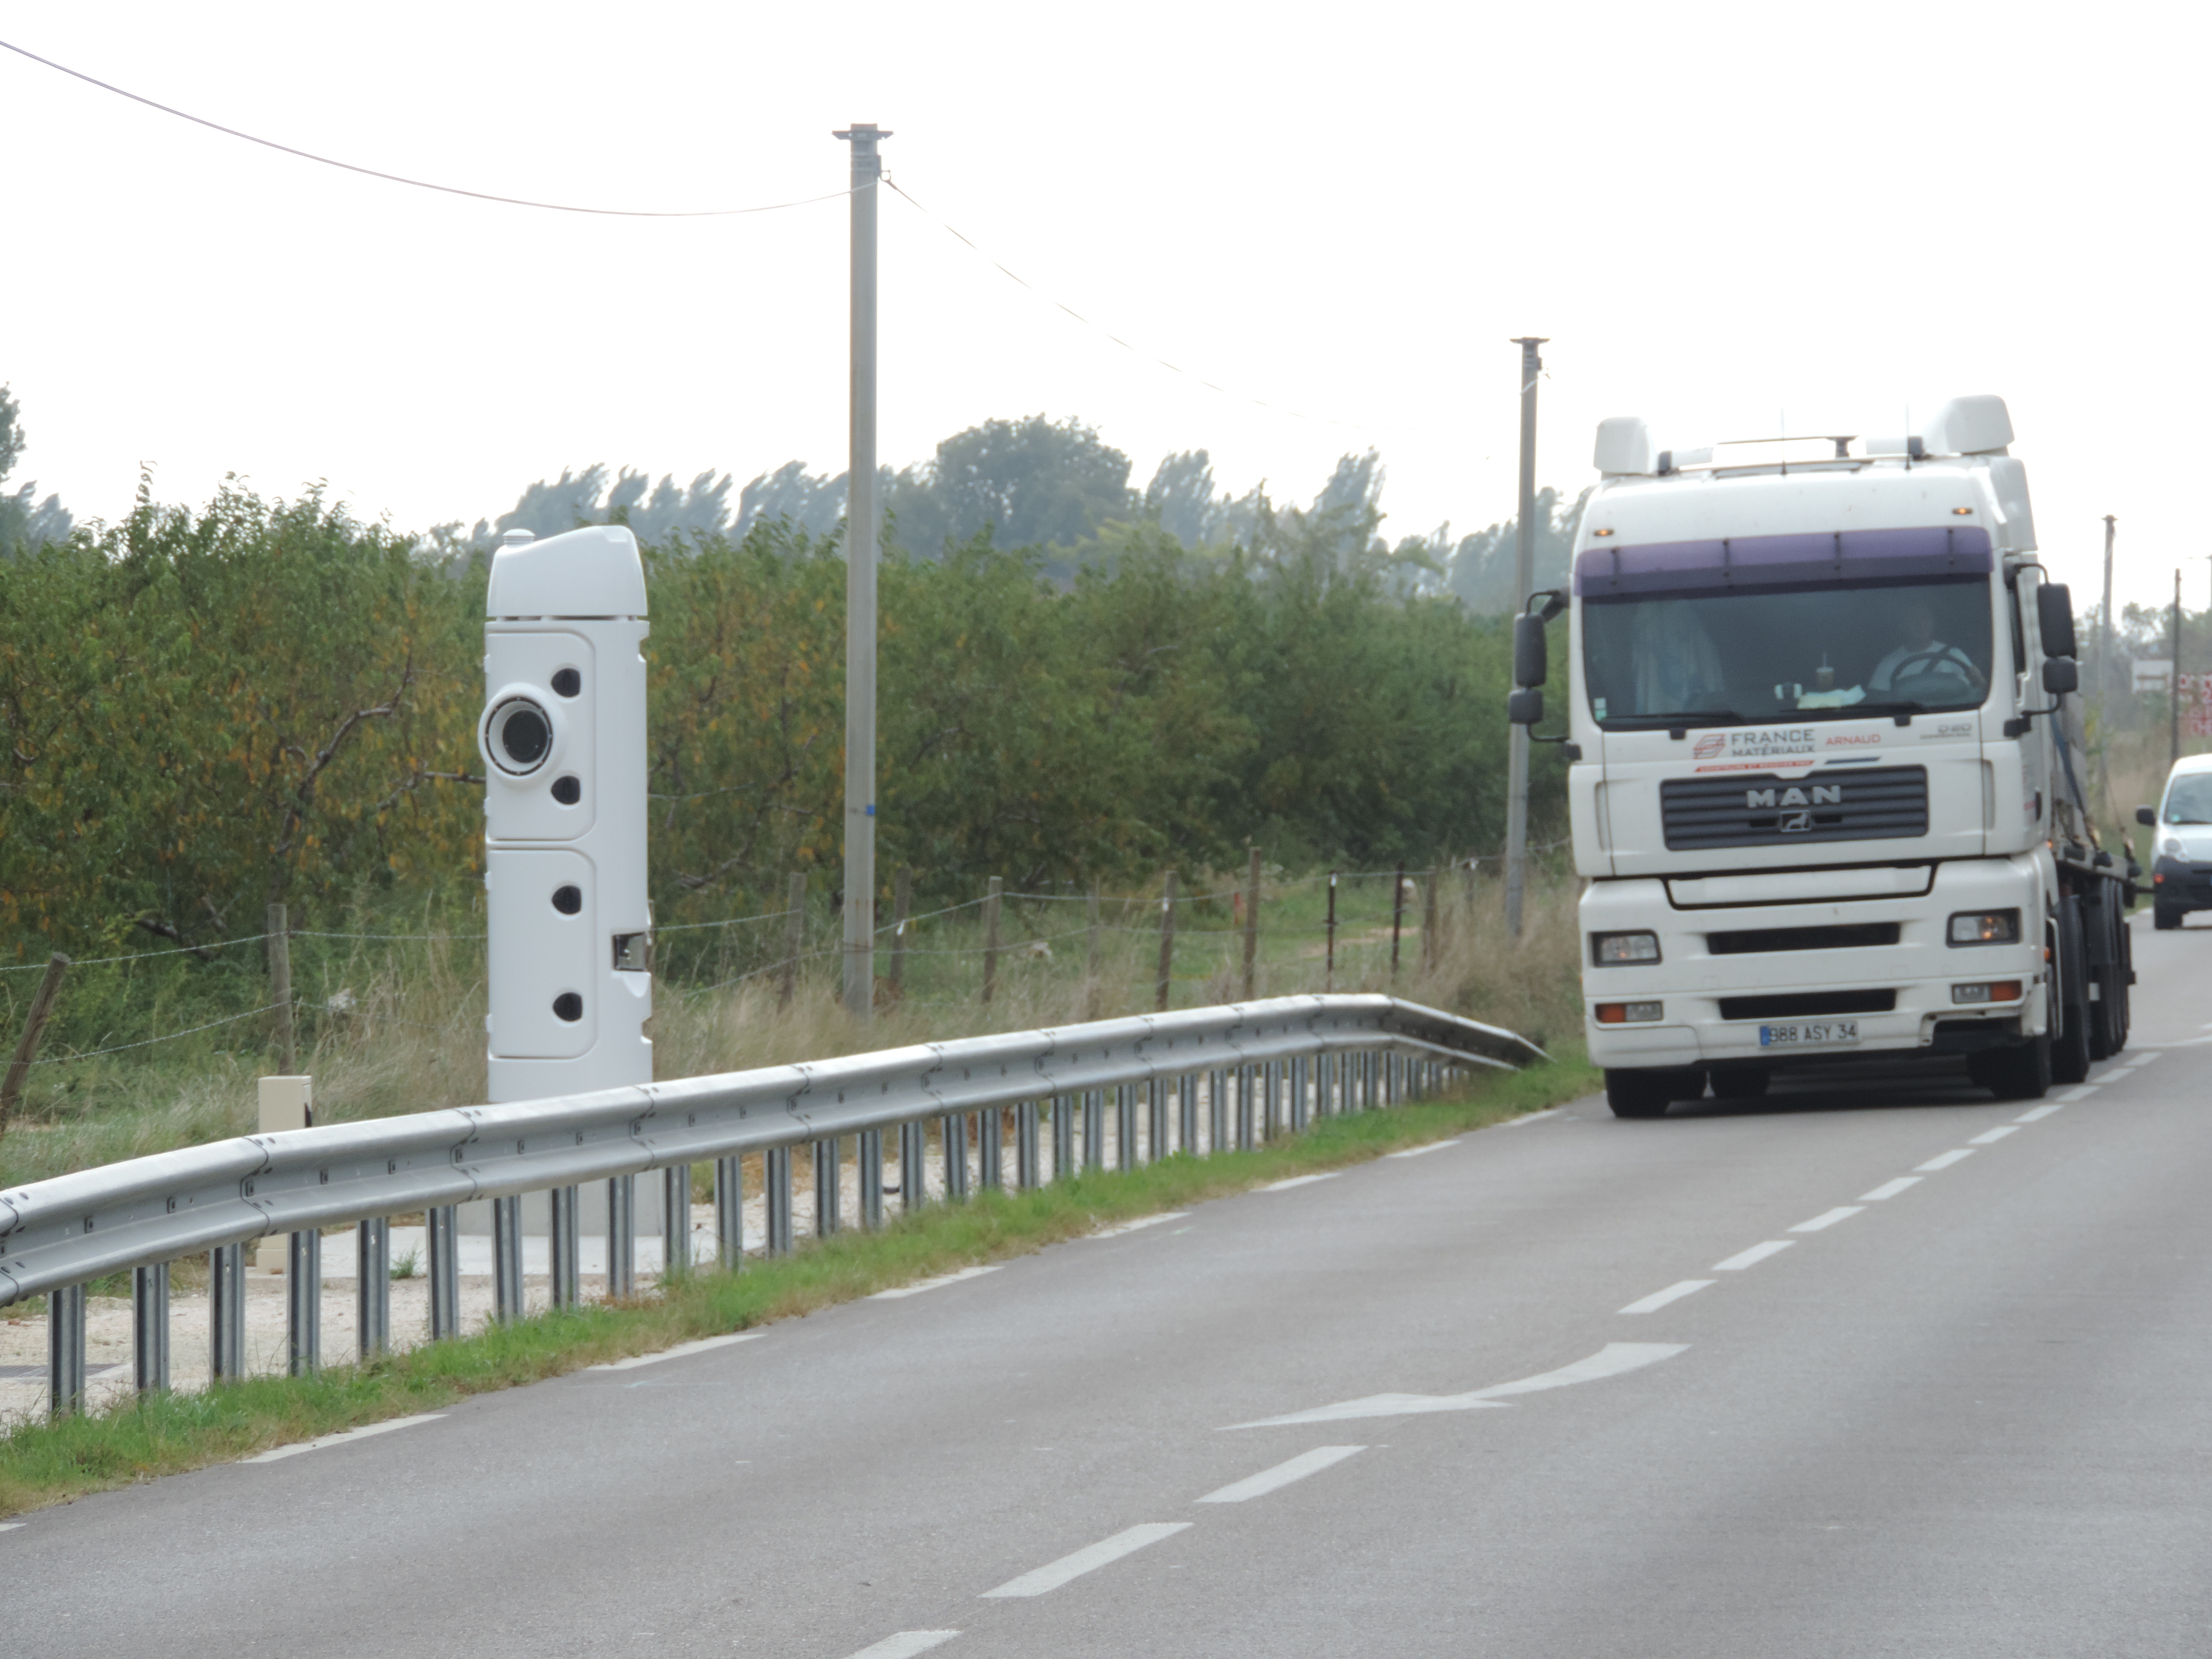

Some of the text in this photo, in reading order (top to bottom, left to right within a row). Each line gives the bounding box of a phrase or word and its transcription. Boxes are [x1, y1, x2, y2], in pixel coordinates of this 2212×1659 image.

[1731, 729, 1815, 745] FRANCE
[1826, 734, 1881, 745] ARNAUD
[1732, 744, 1815, 757] MATÉRIAUX
[1747, 785, 1841, 808] MAN
[1805, 1025, 1831, 1040] ASY
[1838, 1023, 1856, 1038] 34
